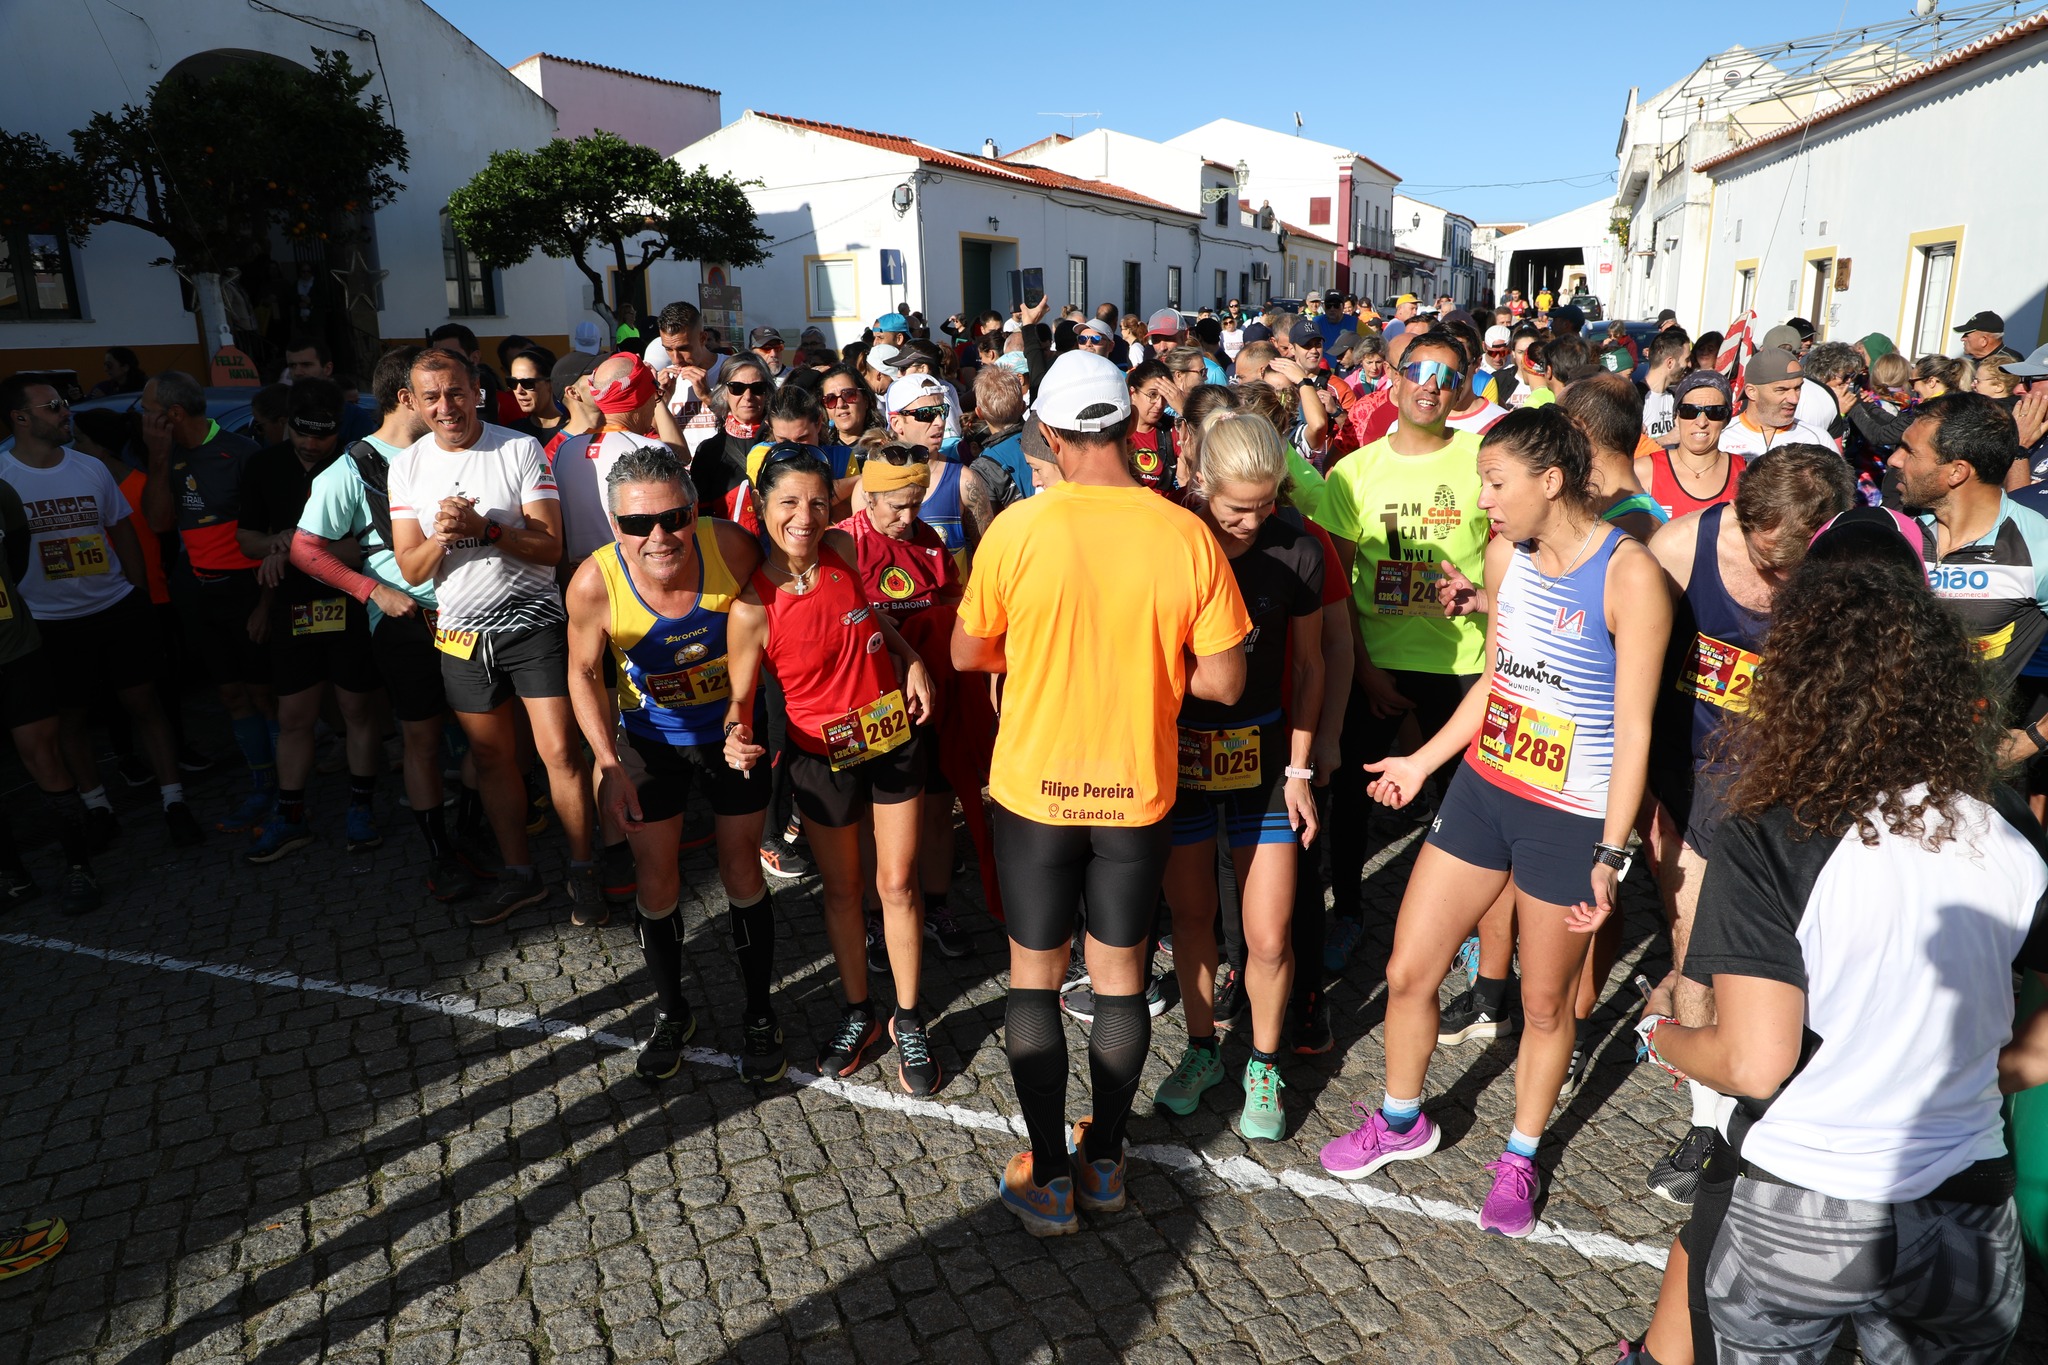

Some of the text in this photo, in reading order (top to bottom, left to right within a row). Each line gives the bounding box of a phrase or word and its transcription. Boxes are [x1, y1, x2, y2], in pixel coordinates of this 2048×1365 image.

[215, 355, 245, 367] FELIZ
[229, 368, 259, 380] NATAL
[1401, 503, 1421, 516] AM
[1428, 506, 1461, 518] Cuba
[28, 518, 45, 527] ILHO
[54, 515, 72, 524] VINHO
[1422, 517, 1461, 526] Running
[1401, 526, 1427, 540] CAN
[75, 548, 104, 566] 115
[1378, 592, 1402, 604] 12KM
[1412, 581, 1440, 603] 24
[882, 601, 889, 609] C
[892, 599, 932, 610] BARONIA
[315, 605, 344, 622] 322
[1495, 647, 1571, 691] Odemira
[1508, 682, 1540, 694] MUNICÍPIO
[1686, 670, 1718, 692] 12KM
[866, 710, 906, 745] 282
[1483, 734, 1506, 757] 12KM
[1514, 732, 1566, 773] 283
[1214, 748, 1258, 776] 025
[1041, 779, 1134, 801] Filipe Pereira
[1062, 808, 1125, 820] Grândola
[1026, 1187, 1051, 1207] HOKA
